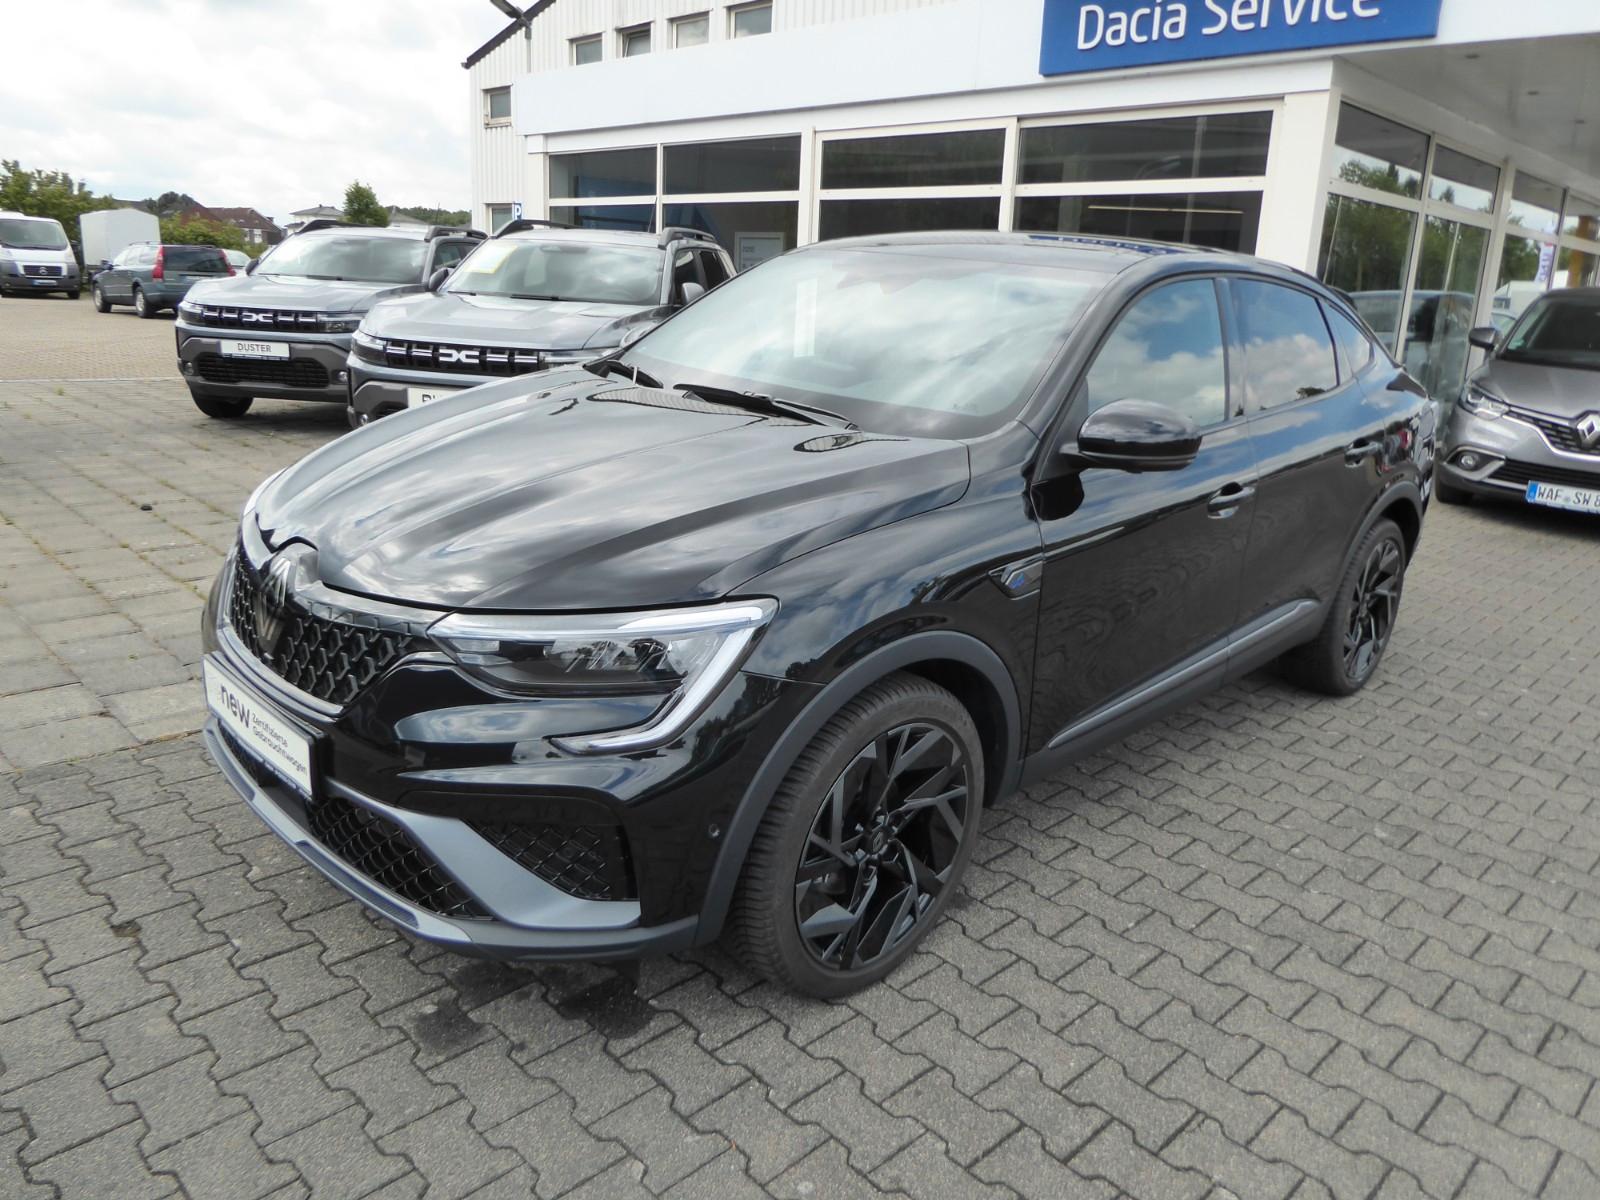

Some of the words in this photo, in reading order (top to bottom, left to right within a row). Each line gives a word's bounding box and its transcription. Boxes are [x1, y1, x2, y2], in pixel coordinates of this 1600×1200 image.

[1077, 1, 1187, 50] Dacia
[514, 204, 522, 220] P
[237, 343, 272, 352] DUSTER
[1538, 486, 1562, 501] WAF
[1573, 491, 1591, 505] SW
[221, 685, 250, 728] new
